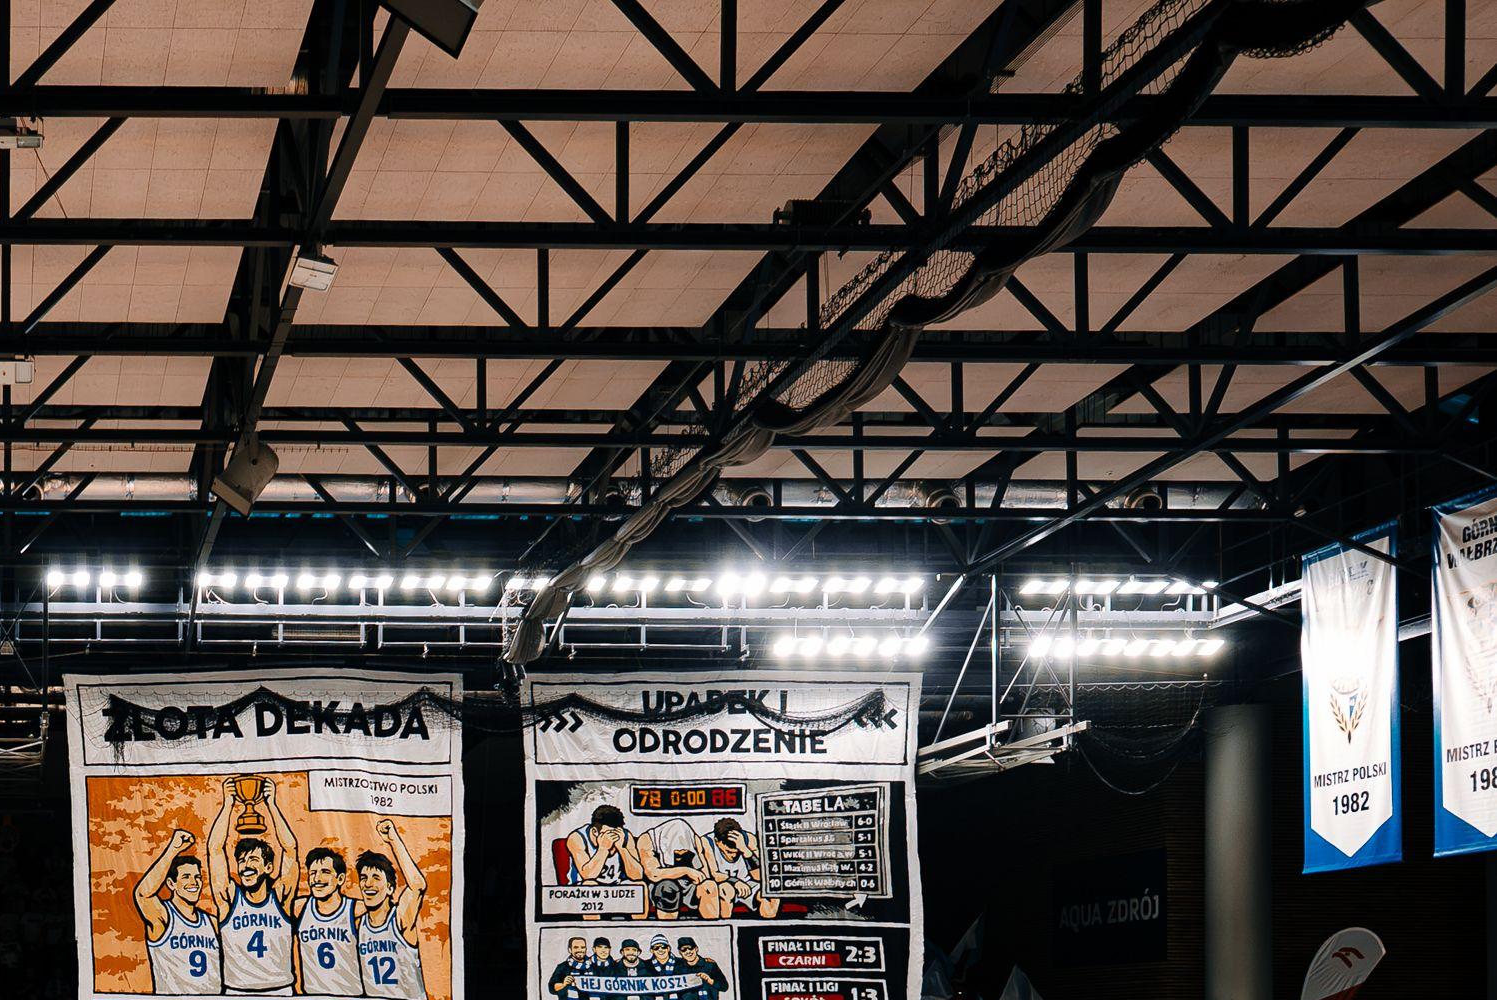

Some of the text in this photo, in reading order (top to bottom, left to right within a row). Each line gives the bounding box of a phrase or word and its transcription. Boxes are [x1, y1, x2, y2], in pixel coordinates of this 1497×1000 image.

[256, 700, 430, 740] DEKADA
[613, 728, 828, 755] ODRODZENIE
[1446, 740, 1490, 763] MISTRZ
[1314, 761, 1387, 788] MISTRZ POLSKI
[400, 782, 438, 795] POLSKI
[370, 795, 393, 808] 1982
[638, 790, 706, 807] 78 0:00
[1332, 791, 1370, 816] 1982
[769, 837, 775, 845] 2
[772, 851, 778, 860] 3
[772, 864, 778, 872] 4
[769, 879, 781, 888] 10
[592, 890, 602, 898] W
[604, 890, 609, 898] 3
[581, 902, 603, 911] 2012
[1107, 888, 1159, 923] ZDRÓJ
[233, 911, 282, 930] GÓRNIK
[170, 934, 217, 950] GÓRNIK
[300, 924, 350, 943] GÓRNIK
[247, 930, 267, 957] 4
[359, 939, 398, 955] GÓRNIK
[768, 941, 876, 963] FINAŁ I LIGI 2:3
[189, 950, 208, 977] 9
[317, 943, 335, 970] 6
[778, 956, 826, 965] CZARNI
[368, 956, 398, 985] 12
[581, 976, 687, 991] HEJ GÓRNIK KOSZ!
[771, 982, 806, 993] FINAŁ
[809, 982, 813, 992] I
[816, 982, 838, 992] LIGI
